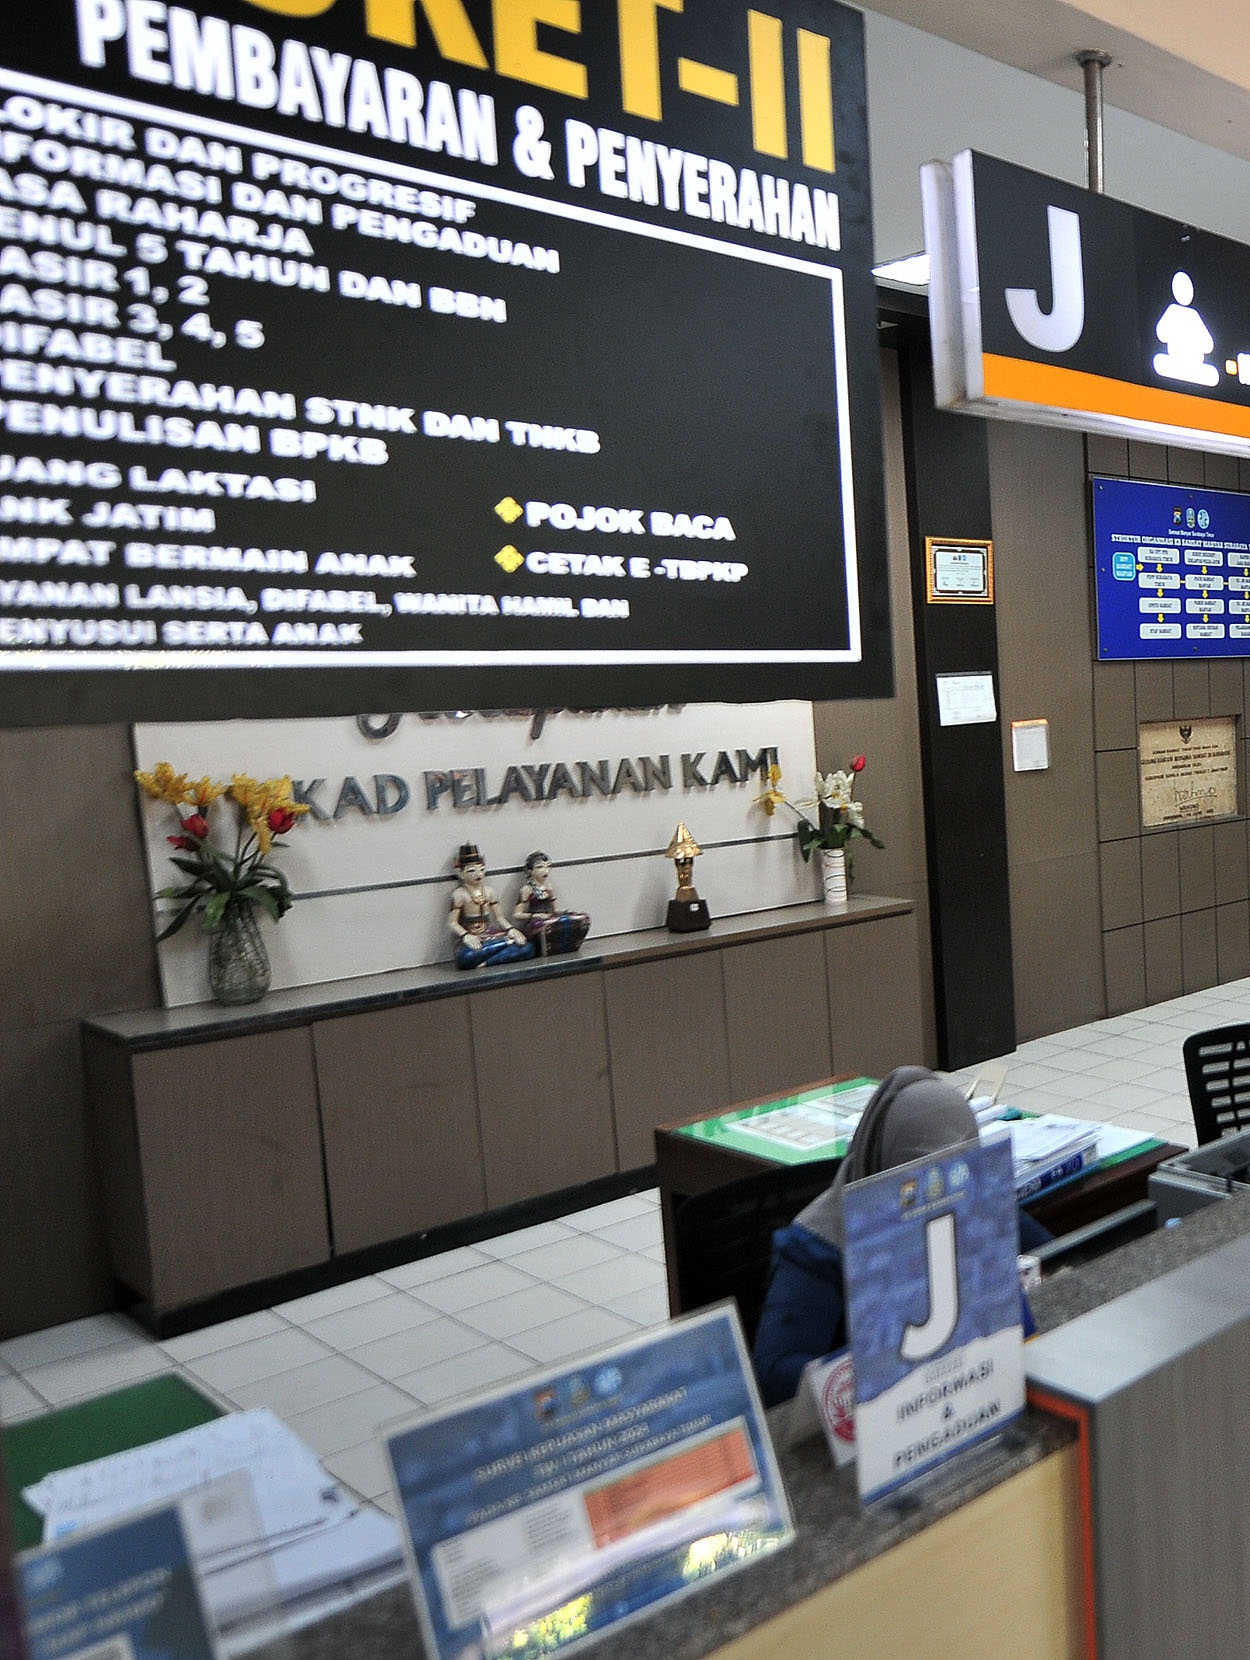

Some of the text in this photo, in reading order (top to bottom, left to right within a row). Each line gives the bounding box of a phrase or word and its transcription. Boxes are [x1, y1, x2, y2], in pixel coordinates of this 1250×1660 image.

[238, 0, 836, 173] ET-II
[75, 0, 841, 251] PEMBAYARAN & PENYERAHAN
[0, 95, 476, 224] OKIR DAN PROGRESIF
[94, 188, 314, 256] RAHARJA
[230, 181, 323, 225] DAN
[330, 203, 560, 274] PENGADUAN
[136, 233, 168, 264] 5
[175, 240, 330, 292] TAHUN
[338, 270, 422, 308] DAN
[428, 287, 507, 323] BBN
[177, 275, 210, 305] 2
[1004, 205, 1085, 353] J
[234, 319, 266, 349] 5
[0, 400, 389, 465] ENULISAN BPKB
[303, 396, 418, 434] STNK
[422, 409, 499, 442] DAN
[505, 420, 601, 454] TNKB
[128, 465, 317, 503] LAKTASI
[81, 502, 216, 534] JATIM
[525, 500, 736, 541] POJOK BACA
[124, 542, 309, 573] BERMAIN
[314, 552, 417, 578] ANAK
[525, 551, 627, 578] CETAK
[124, 583, 258, 615] LANSIA,
[259, 587, 393, 617] DIFABEL,
[160, 620, 269, 646] SERTA
[272, 621, 364, 646] ANAK
[292, 773, 411, 822] KAD
[422, 754, 672, 811] PELAYANAN
[900, 1212, 960, 1361] J
